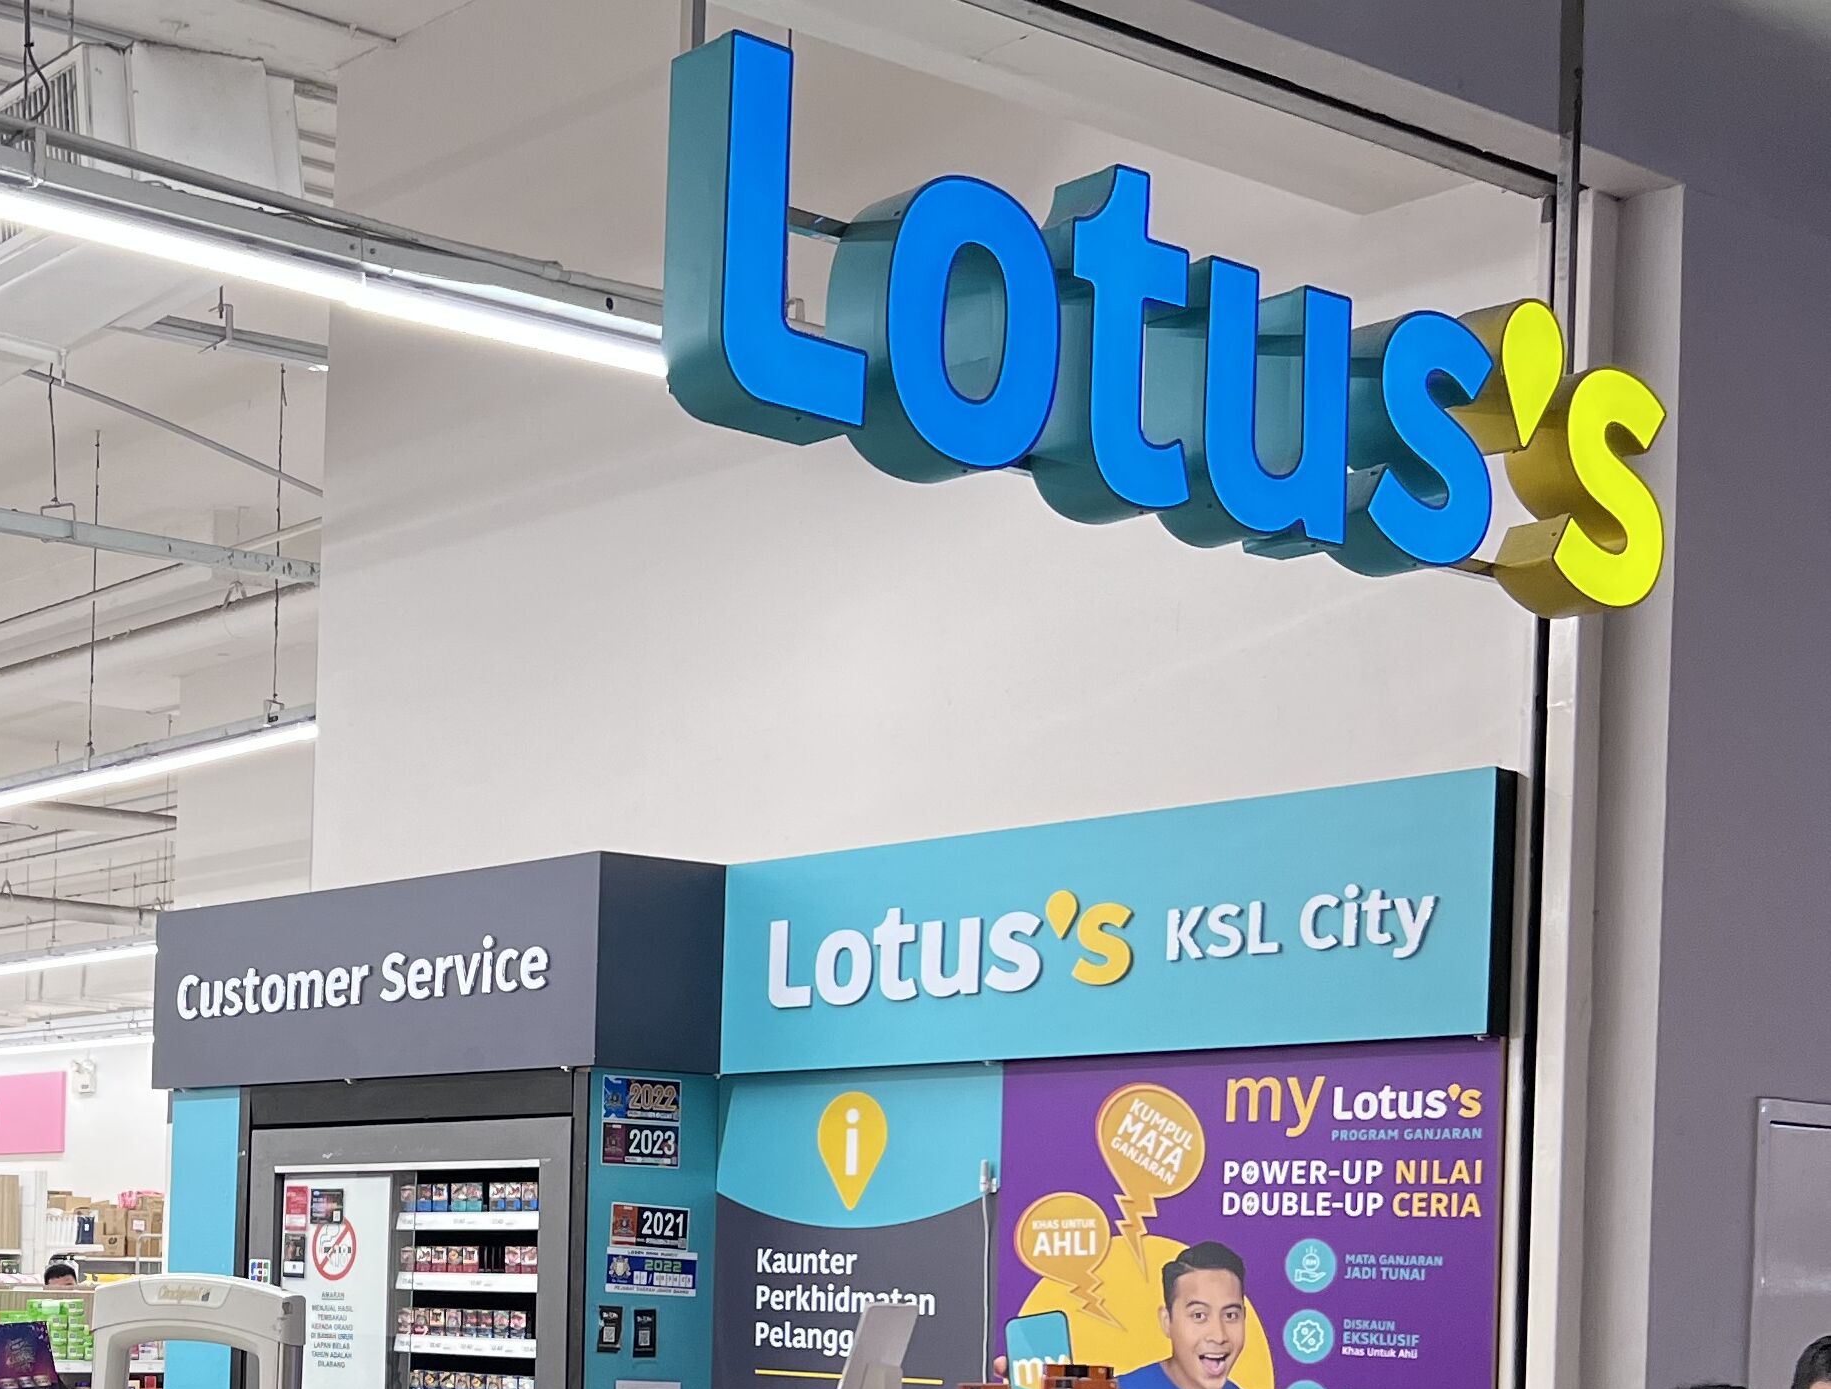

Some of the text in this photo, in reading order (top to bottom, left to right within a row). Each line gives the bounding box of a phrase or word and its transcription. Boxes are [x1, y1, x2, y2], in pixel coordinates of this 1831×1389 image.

[720, 28, 1667, 610] Lotus's
[768, 884, 1437, 1009] Lotus's KSL City
[176, 934, 550, 1020] Customer Service
[629, 1083, 677, 1111] 2022
[1225, 1075, 1482, 1138] my Lotus's
[1129, 1099, 1194, 1151] KUMPUL
[1331, 1128, 1482, 1142] PROGRAM GANJARAN
[628, 1129, 676, 1155] 2023
[1117, 1113, 1185, 1173] MATA
[1110, 1136, 1176, 1186] GANJARAN
[1223, 1160, 1482, 1185] POWER-UP NILAI
[1222, 1192, 1482, 1218] DOUBLE-UP CERIA
[641, 1211, 684, 1237] 2021
[1032, 1219, 1097, 1230] KHAS UNTUK
[1032, 1231, 1097, 1256] AHLI
[644, 1259, 682, 1272] 2022
[756, 1248, 858, 1275] Kaunter
[1345, 1254, 1443, 1266] MATA GANJARAN
[1345, 1267, 1425, 1281] JADI TUNAI
[1343, 1319, 1395, 1331] DISKAUN
[1342, 1331, 1420, 1348] EKSKLUSIF
[1342, 1346, 1417, 1359] Khas Untuk Ahli
